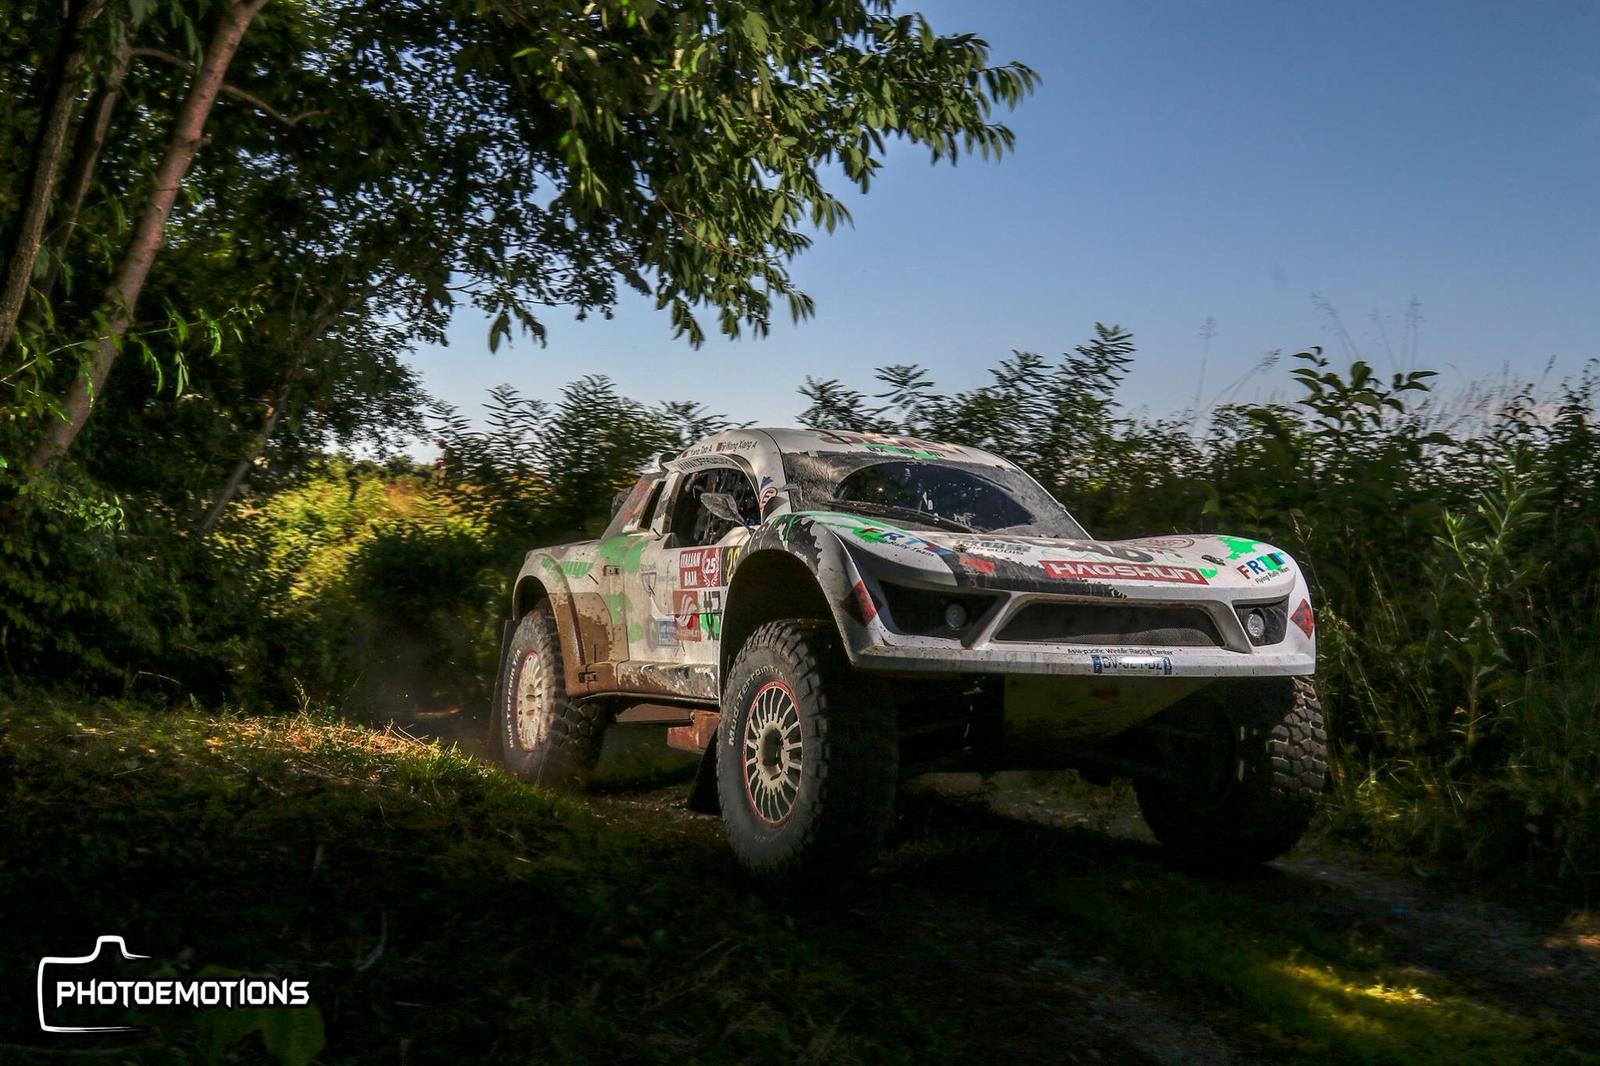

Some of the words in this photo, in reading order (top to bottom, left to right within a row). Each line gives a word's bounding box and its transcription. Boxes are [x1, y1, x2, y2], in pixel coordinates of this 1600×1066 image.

[681, 552, 701, 568] ITALIAN
[705, 558, 716, 574] 25
[1053, 563, 1199, 581] HAOSHUN
[728, 665, 769, 747] Mud-Terrain
